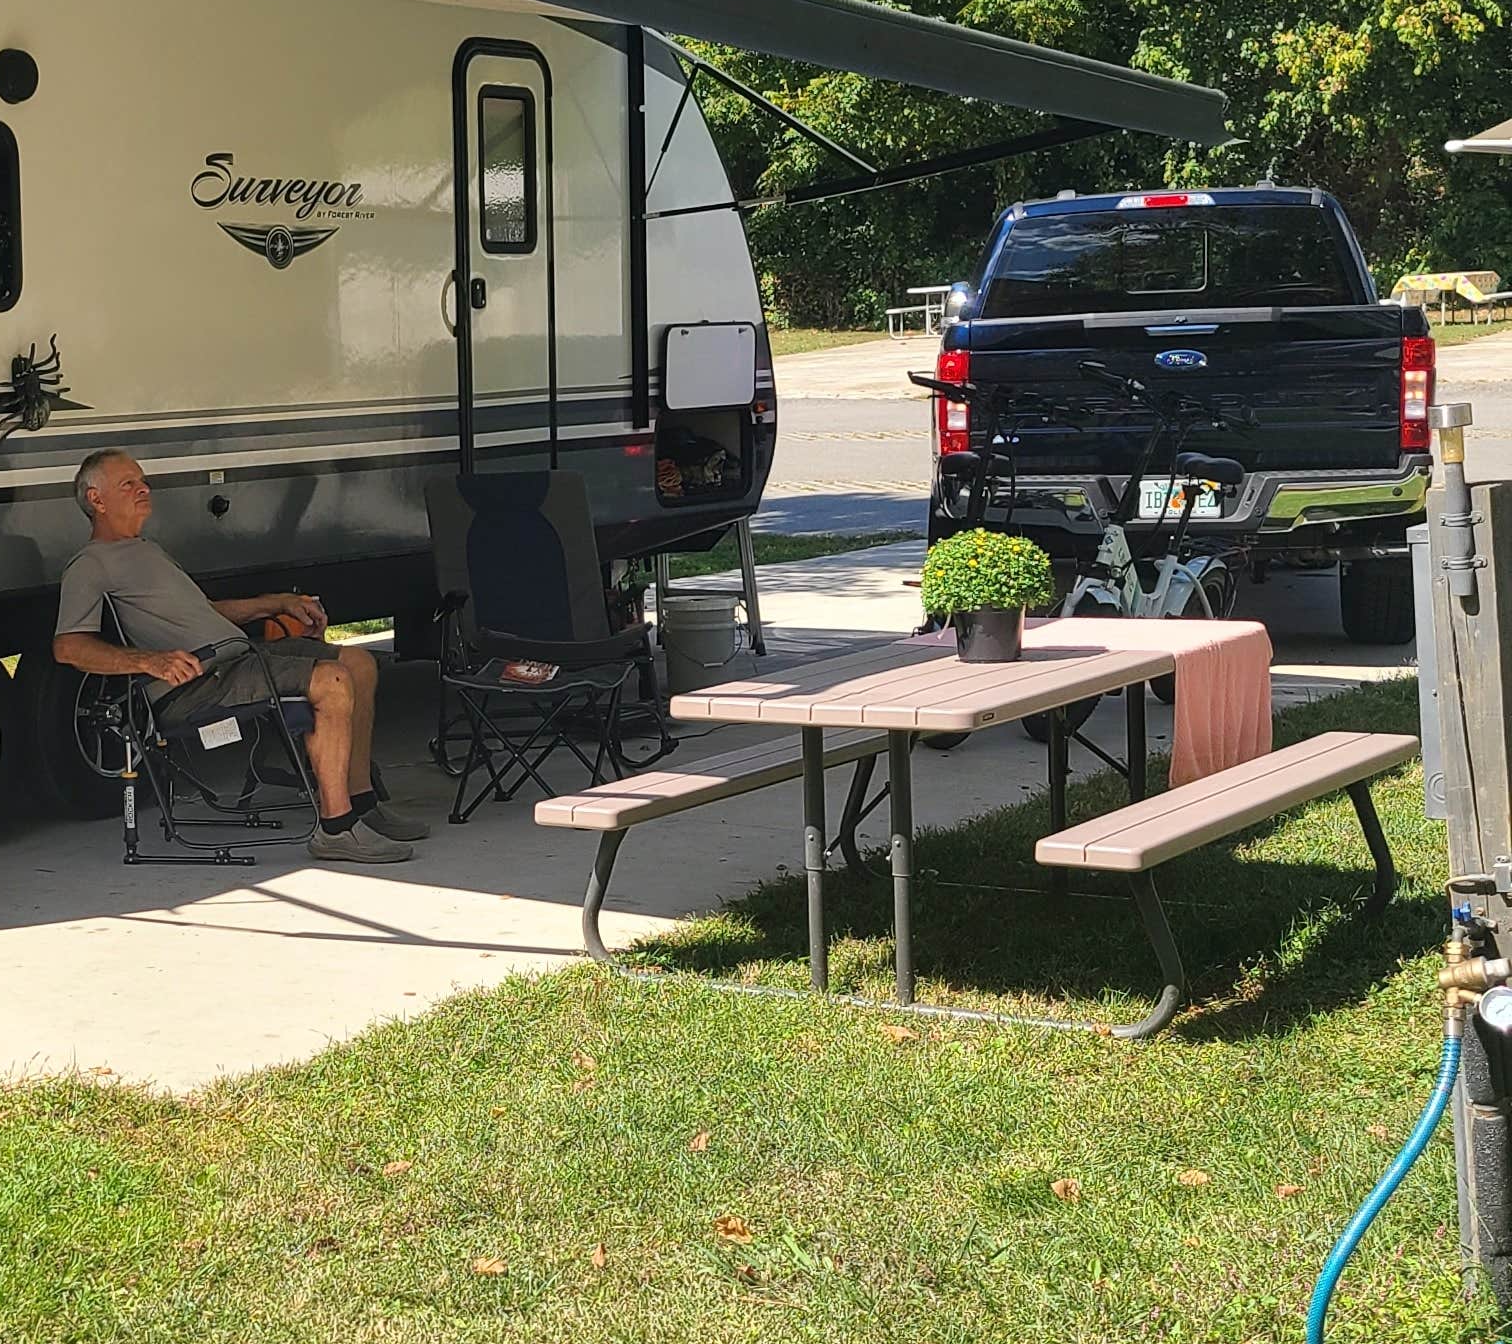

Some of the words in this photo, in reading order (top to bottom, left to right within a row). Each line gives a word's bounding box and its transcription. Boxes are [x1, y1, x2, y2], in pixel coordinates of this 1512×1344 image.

[191, 152, 364, 219] Surveyor
[316, 210, 326, 218] BY
[327, 210, 353, 219] FOREST
[354, 211, 375, 220] RIVER
